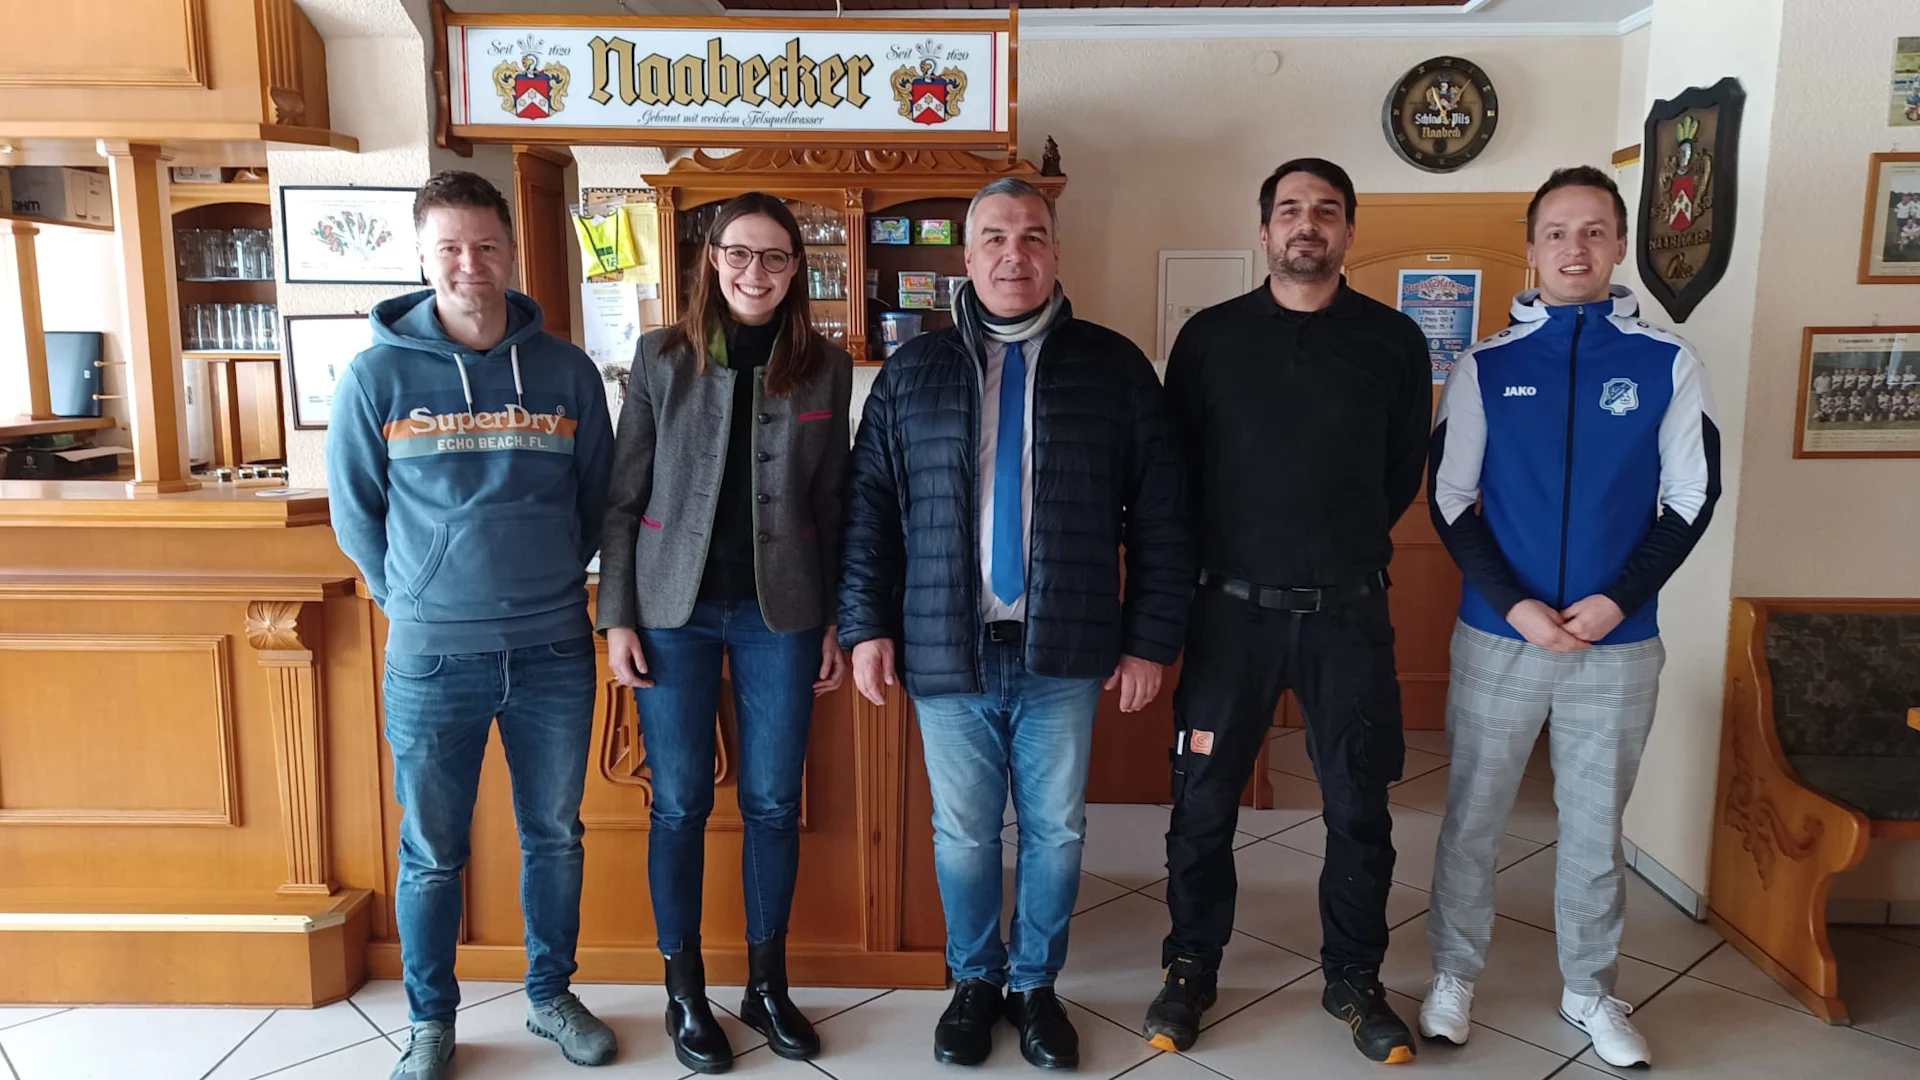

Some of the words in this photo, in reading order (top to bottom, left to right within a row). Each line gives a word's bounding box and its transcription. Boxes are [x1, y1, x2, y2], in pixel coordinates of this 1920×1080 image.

[487, 40, 513, 56] Seit
[548, 44, 571, 56] 1620
[886, 44, 912, 60] Seit
[946, 49, 969, 61] 1620
[588, 35, 874, 108] Naabecker
[638, 109, 680, 125] Gebraut
[683, 110, 699, 122] mit
[700, 111, 739, 123] weichem
[1503, 386, 1537, 397] JAKO
[437, 438, 475, 451] ECHO
